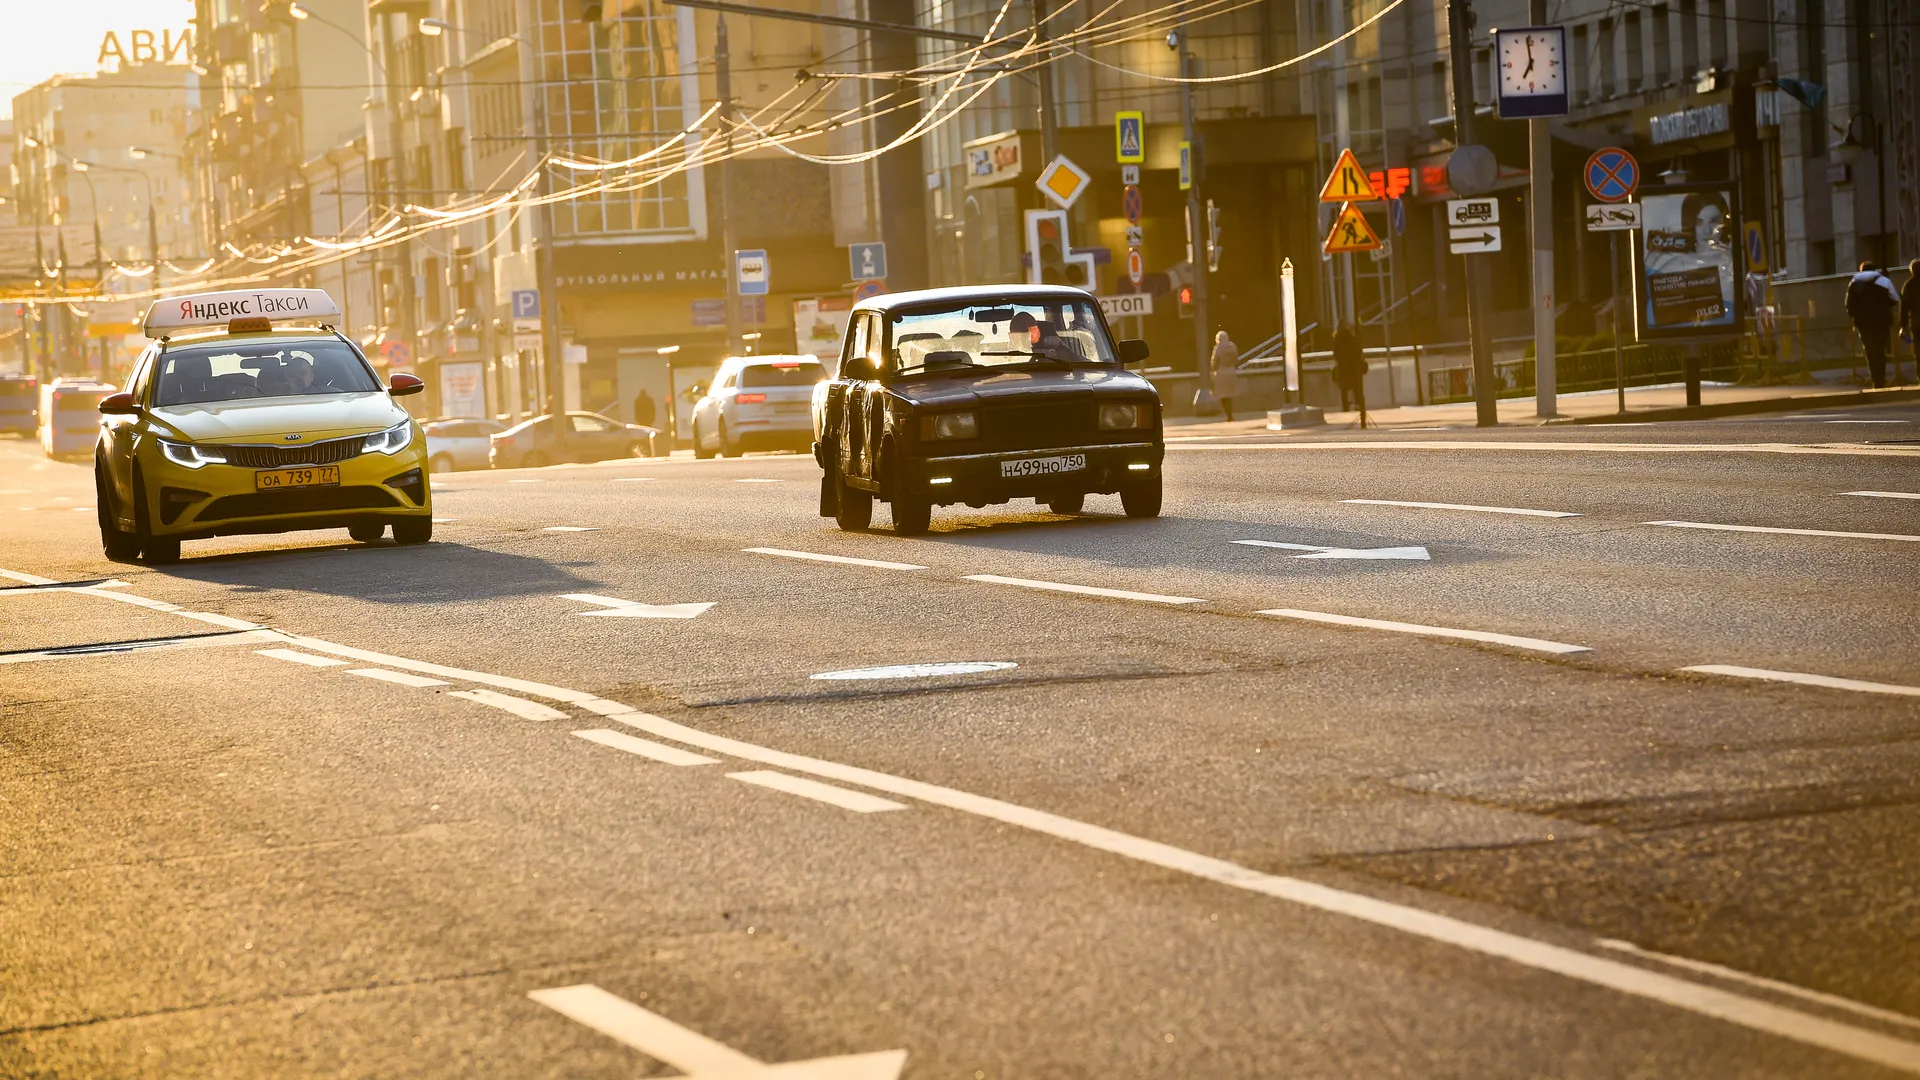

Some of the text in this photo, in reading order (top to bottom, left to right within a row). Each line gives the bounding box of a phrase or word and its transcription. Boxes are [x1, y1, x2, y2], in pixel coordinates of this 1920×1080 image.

[97, 28, 193, 65] АВИ
[181, 294, 309, 320] Яндекс Такси
[518, 292, 535, 316] P
[1100, 297, 1144, 314] СТОП
[1696, 303, 1721, 317] TELE2
[1061, 455, 1084, 468] 750
[286, 470, 313, 485] 739
[320, 467, 334, 478] 77
